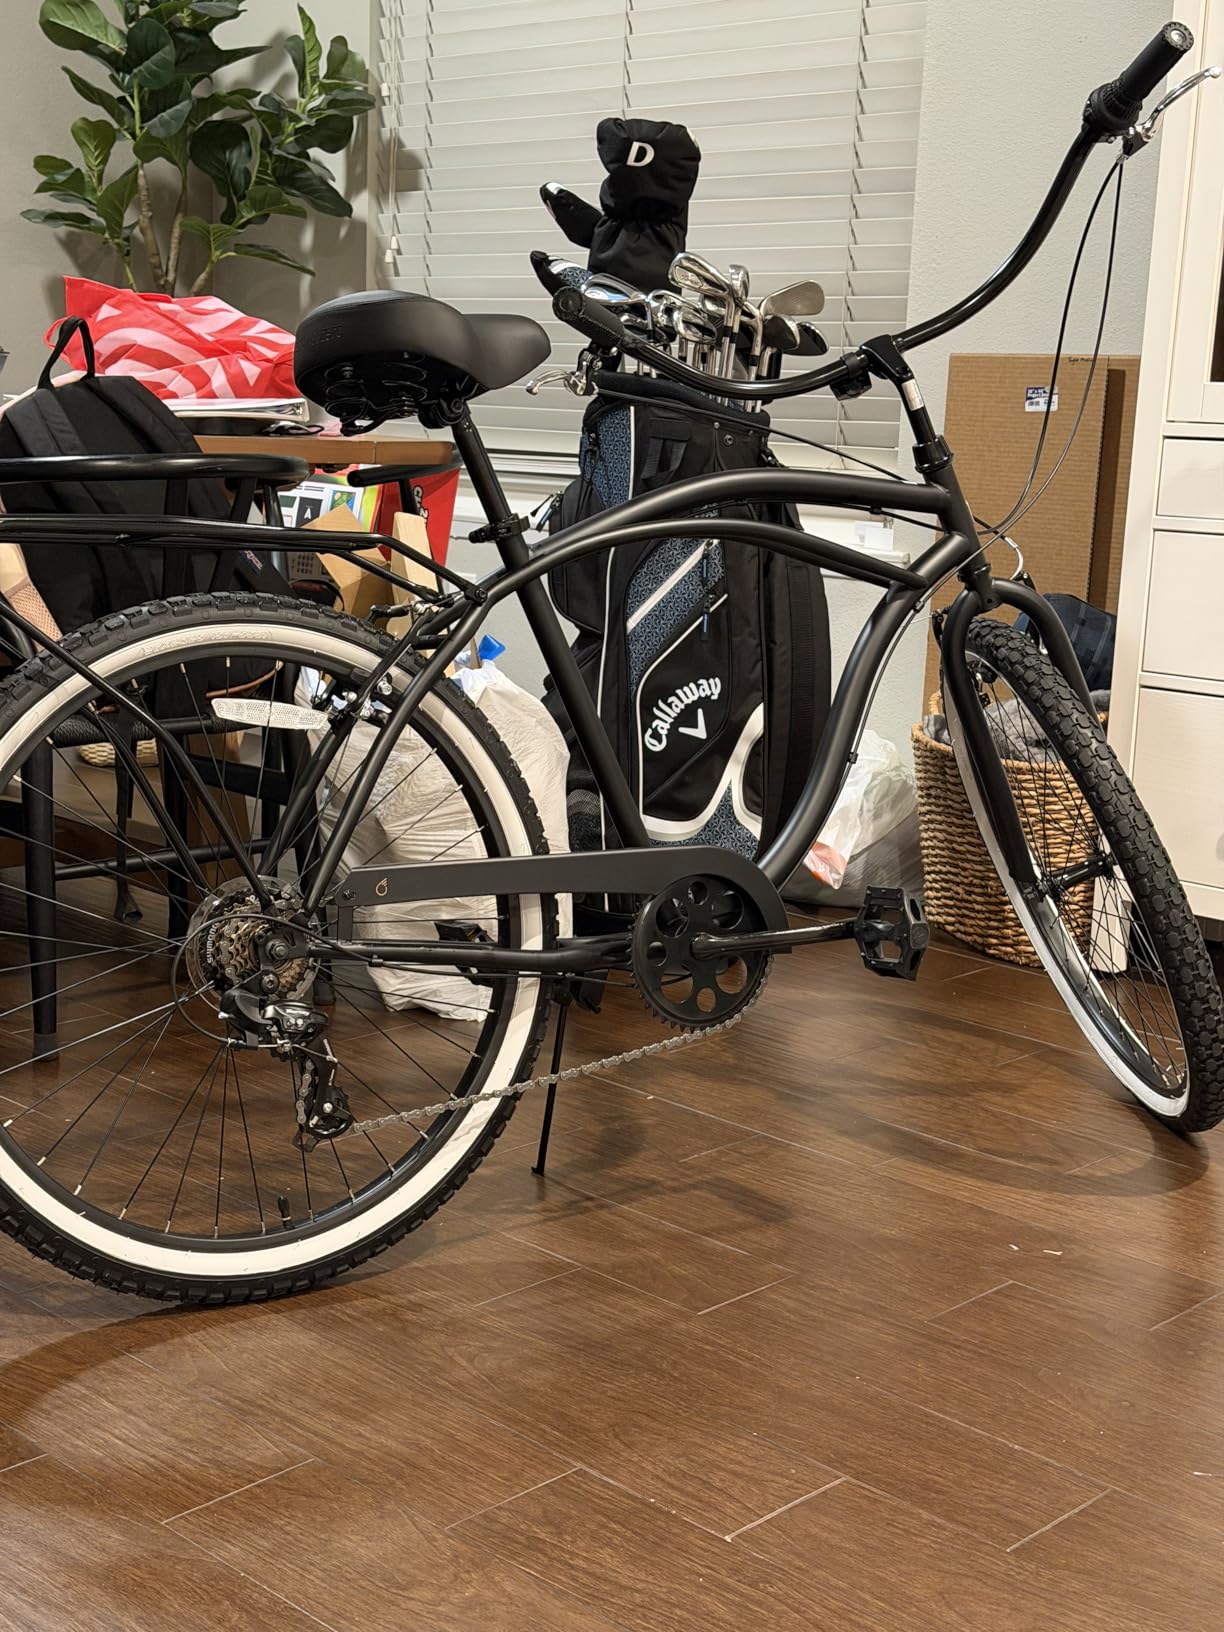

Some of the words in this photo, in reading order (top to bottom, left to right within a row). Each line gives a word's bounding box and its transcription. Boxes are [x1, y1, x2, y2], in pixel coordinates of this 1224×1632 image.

[626, 141, 655, 167] D
[304, 507, 312, 519] A
[644, 677, 722, 752] Callaway
